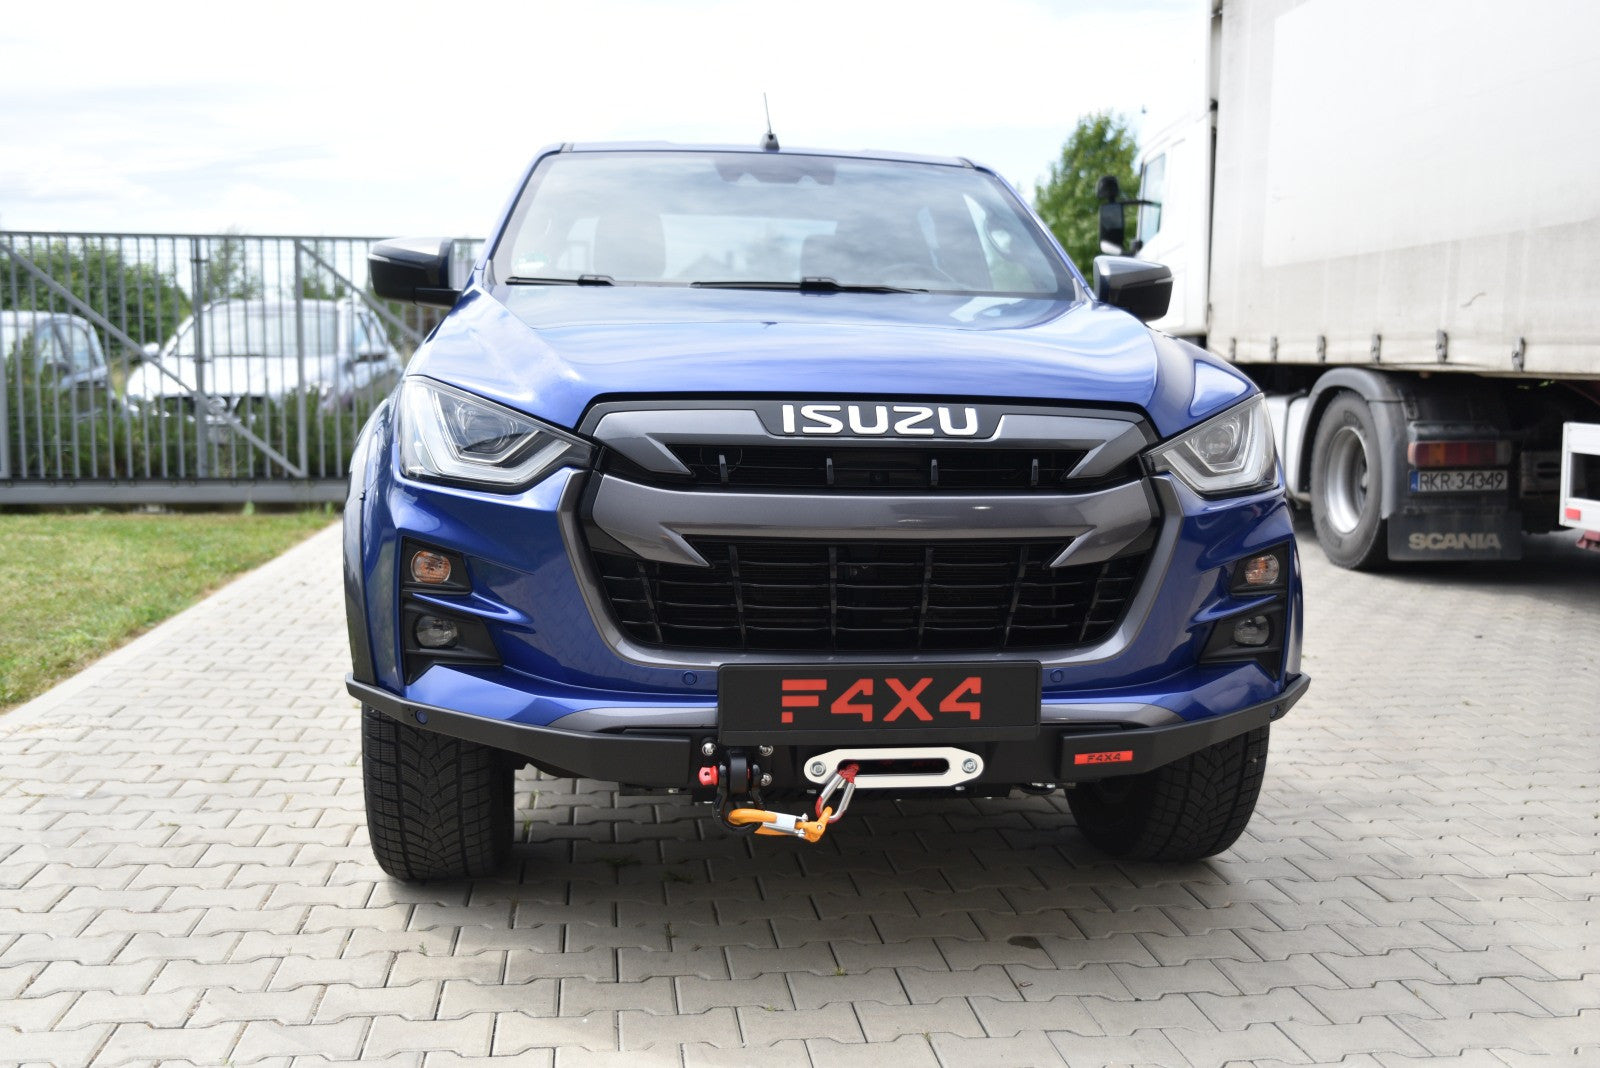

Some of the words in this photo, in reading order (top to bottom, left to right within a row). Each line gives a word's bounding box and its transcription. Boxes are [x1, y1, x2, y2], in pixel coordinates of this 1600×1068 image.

[782, 404, 978, 436] ISUZU
[1420, 472, 1450, 490] RKR
[1456, 472, 1504, 489] 34349
[1408, 532, 1502, 550] SCANIA
[780, 676, 982, 723] F4X4
[1087, 752, 1121, 762] F4X4
